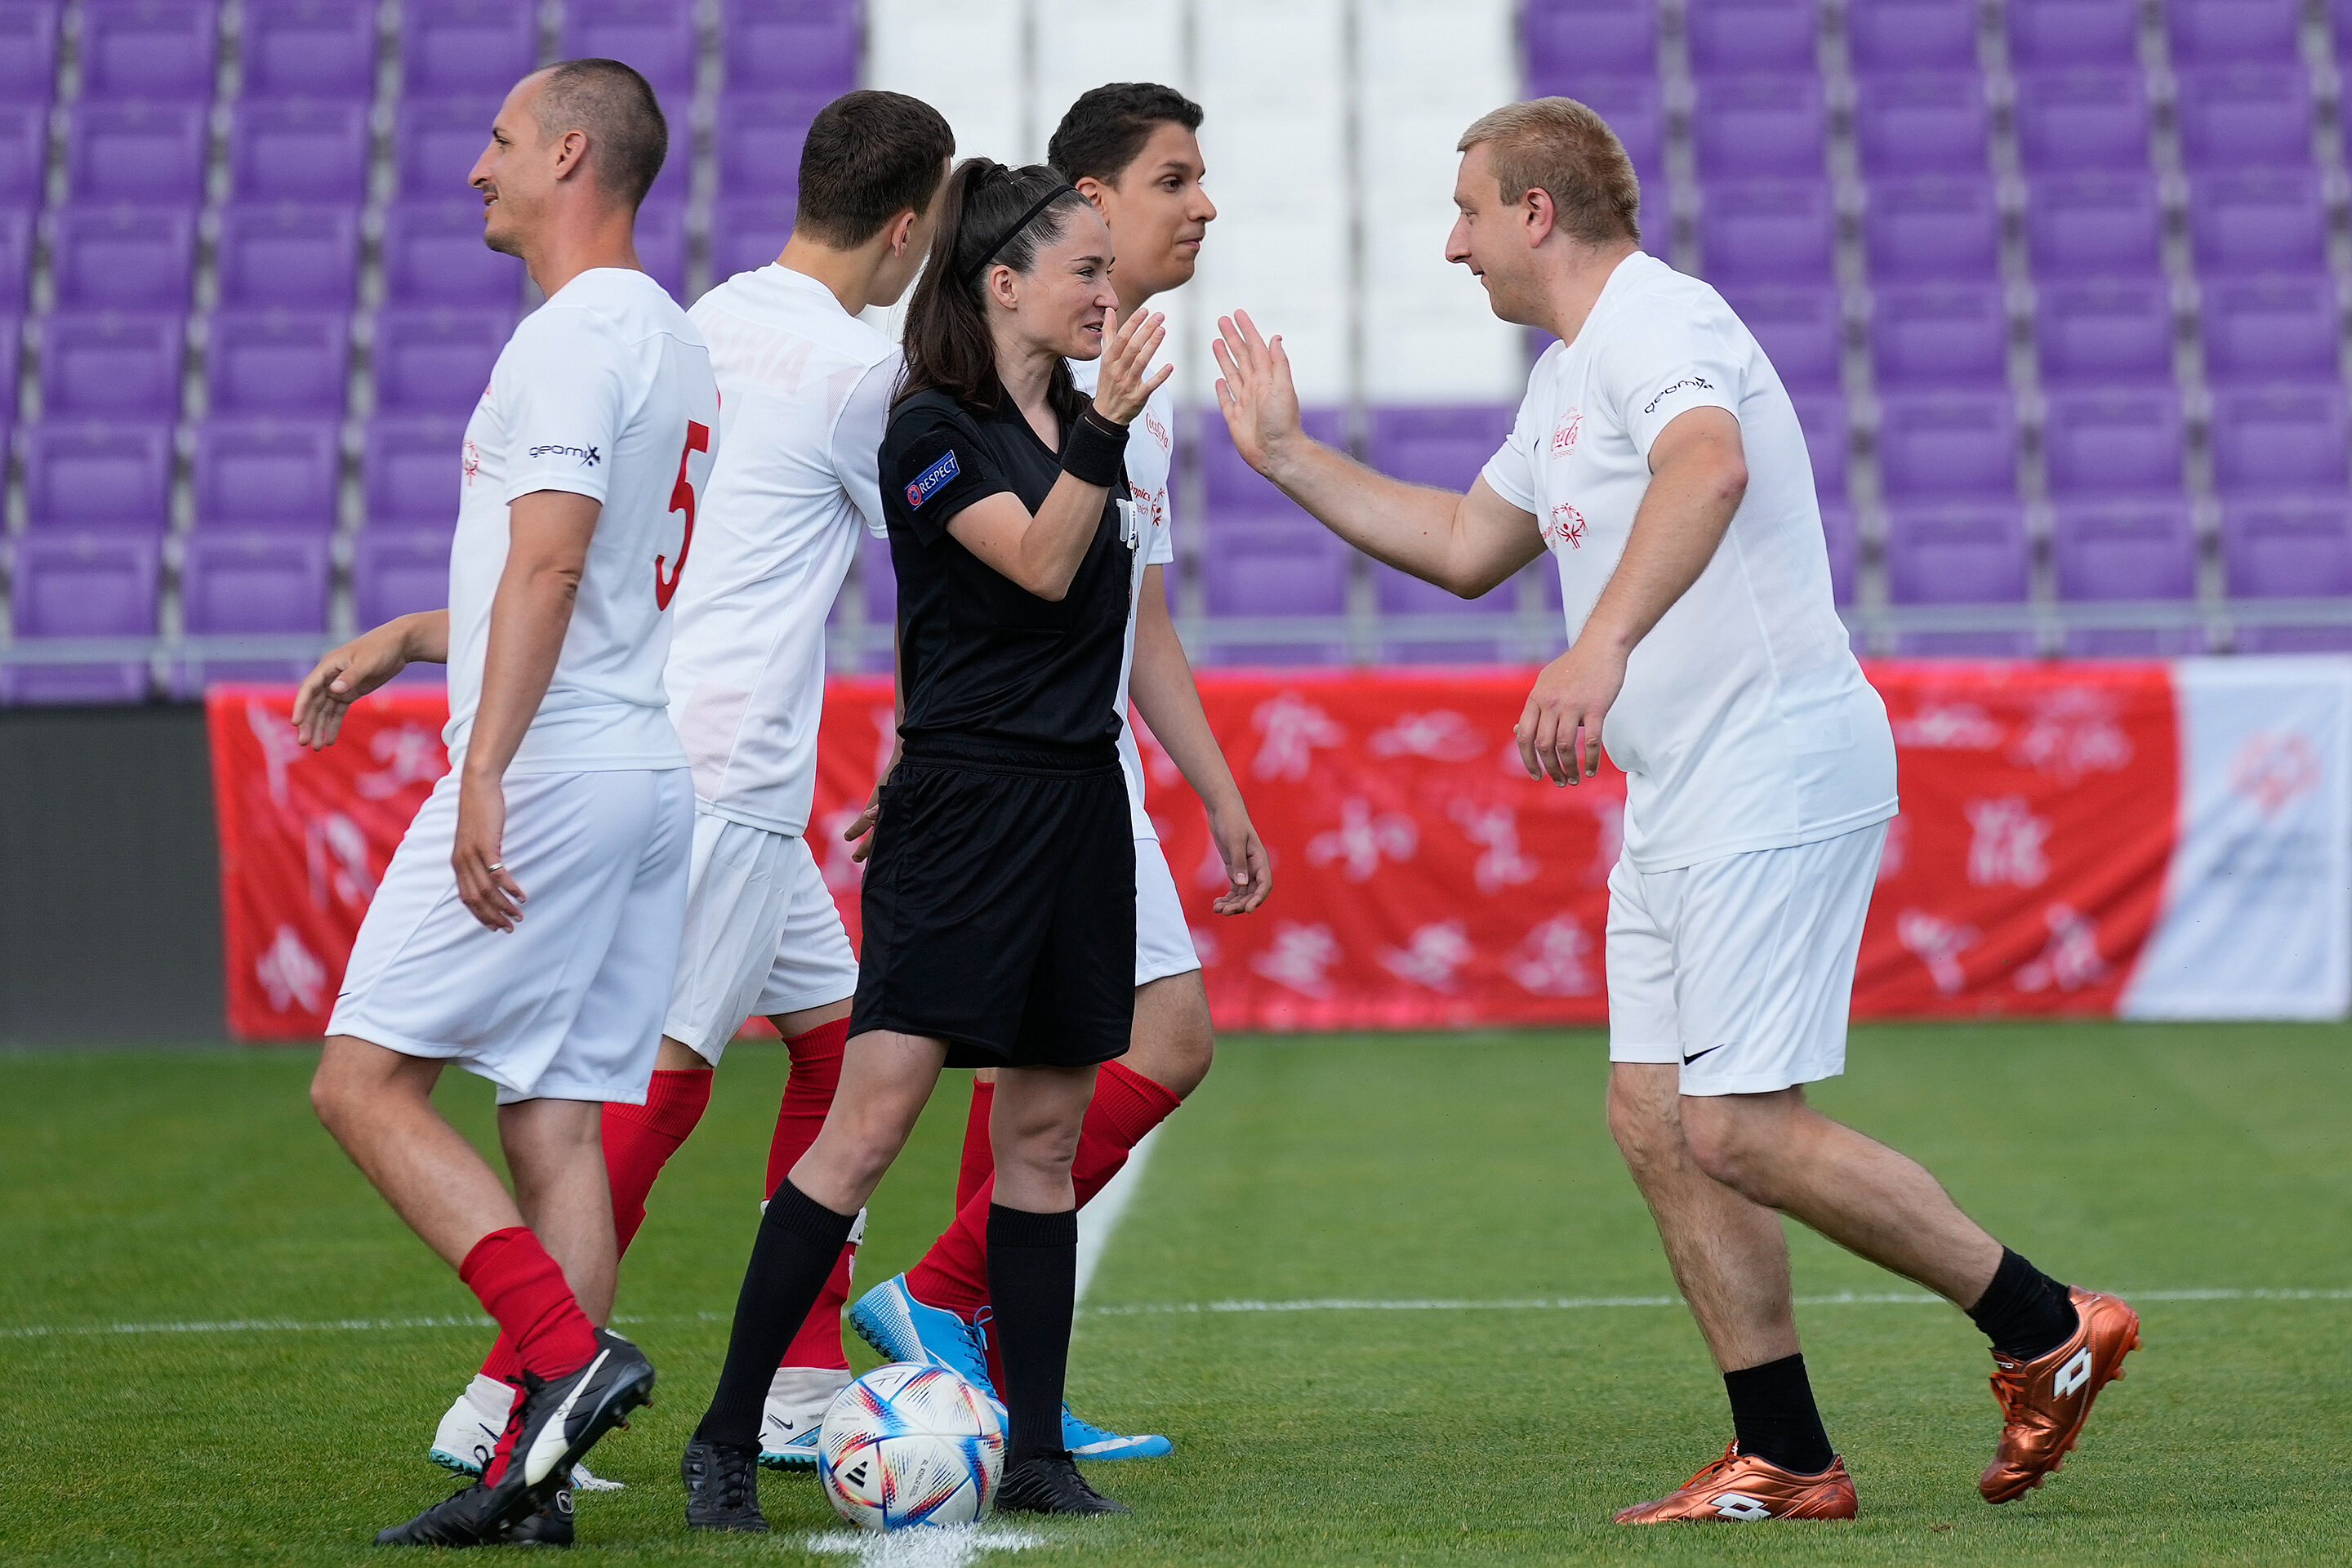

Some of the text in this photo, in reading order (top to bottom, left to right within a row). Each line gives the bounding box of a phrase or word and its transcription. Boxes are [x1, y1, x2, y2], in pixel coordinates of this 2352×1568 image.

[528, 442, 601, 468] geomix
[919, 457, 956, 494] RESPECT
[655, 419, 710, 612] 5
